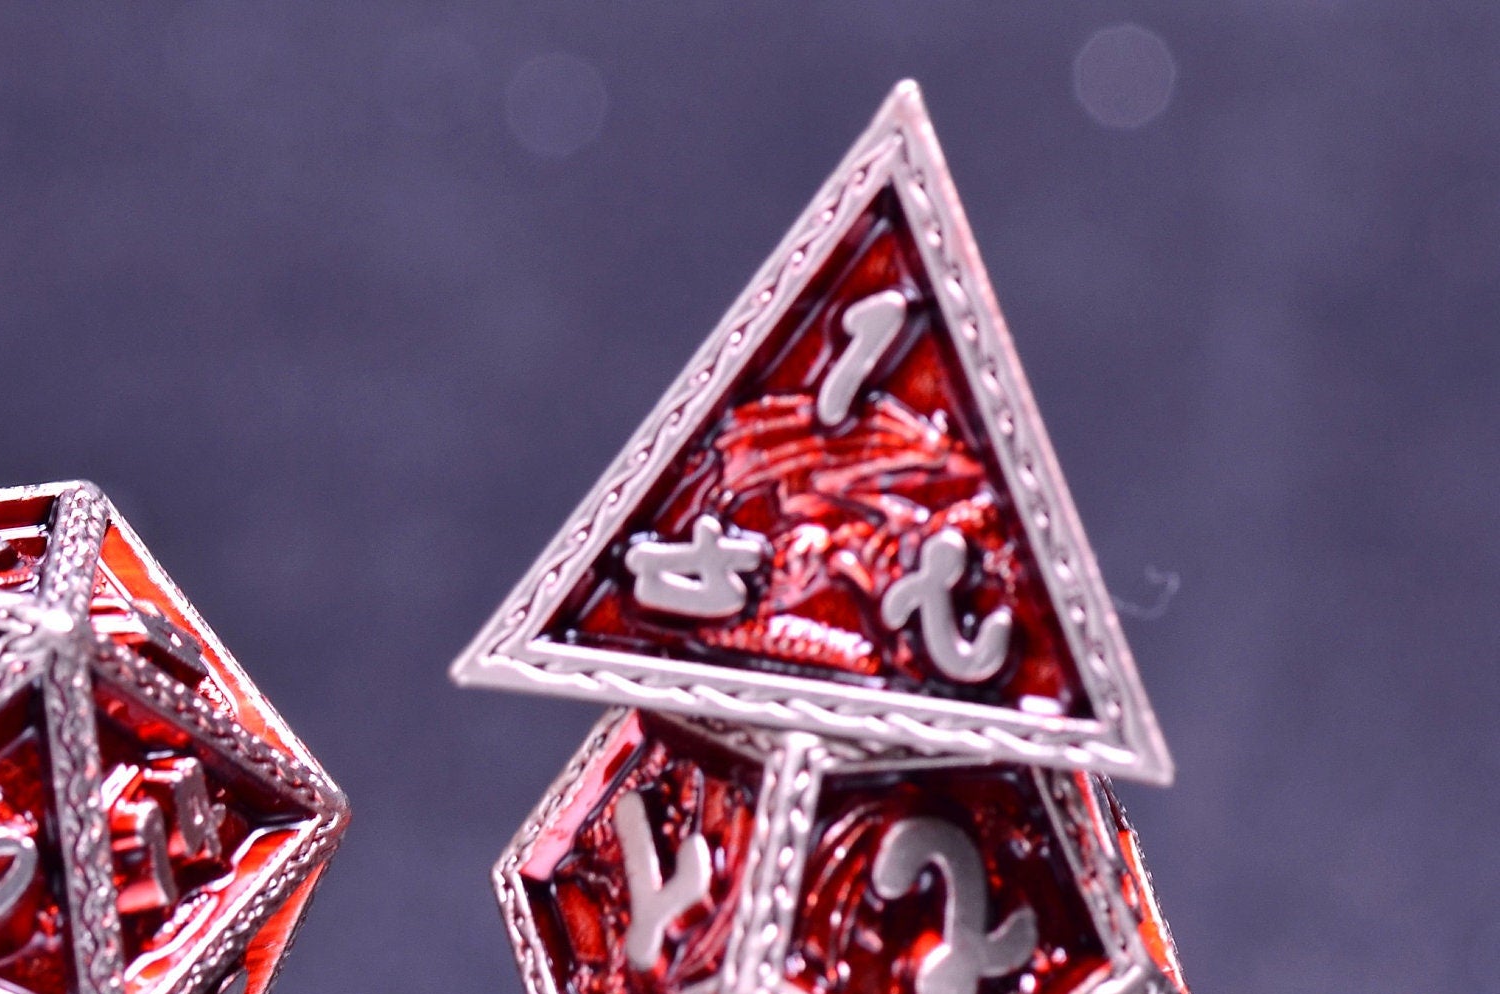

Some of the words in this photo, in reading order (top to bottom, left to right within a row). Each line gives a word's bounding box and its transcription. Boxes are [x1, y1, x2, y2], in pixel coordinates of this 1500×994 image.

[818, 290, 907, 426] 1
[626, 515, 764, 618] 4
[883, 528, 1012, 683] 2
